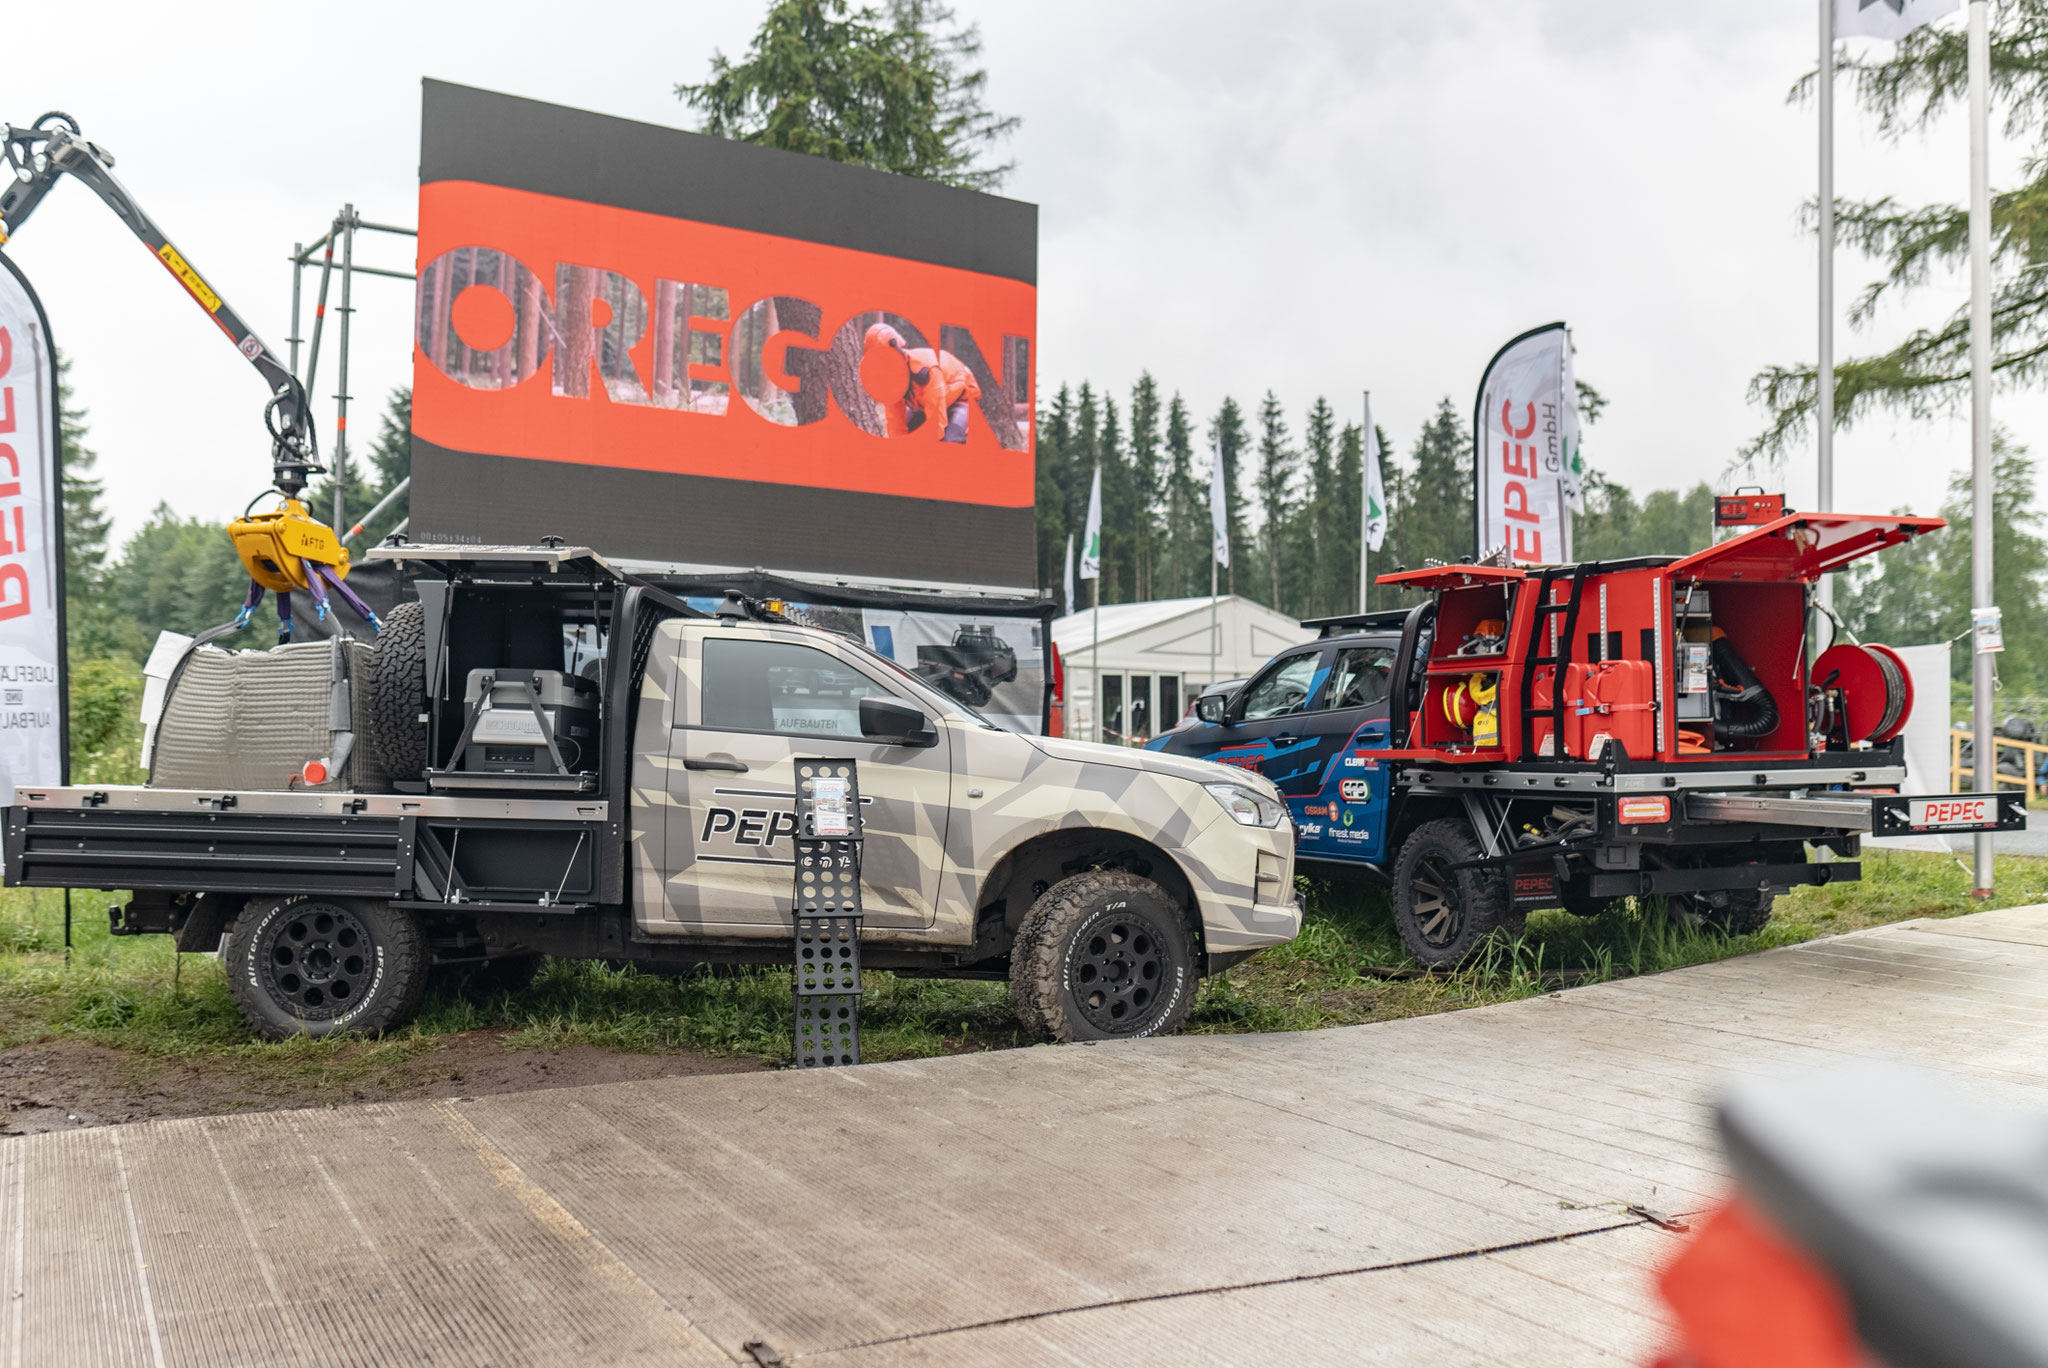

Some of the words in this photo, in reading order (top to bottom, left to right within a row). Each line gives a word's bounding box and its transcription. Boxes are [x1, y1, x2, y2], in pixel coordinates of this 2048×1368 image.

[416, 245, 1030, 453] OREGON
[1542, 403, 1559, 473] GmbH
[780, 718, 838, 729] AUFBAUTEN
[1304, 805, 1328, 816] OSRAM
[1924, 801, 1985, 823] PEPEC
[1514, 878, 1553, 890] PEPEC
[1105, 901, 1127, 912] T/A
[334, 945, 384, 1025] BFGoodrich
